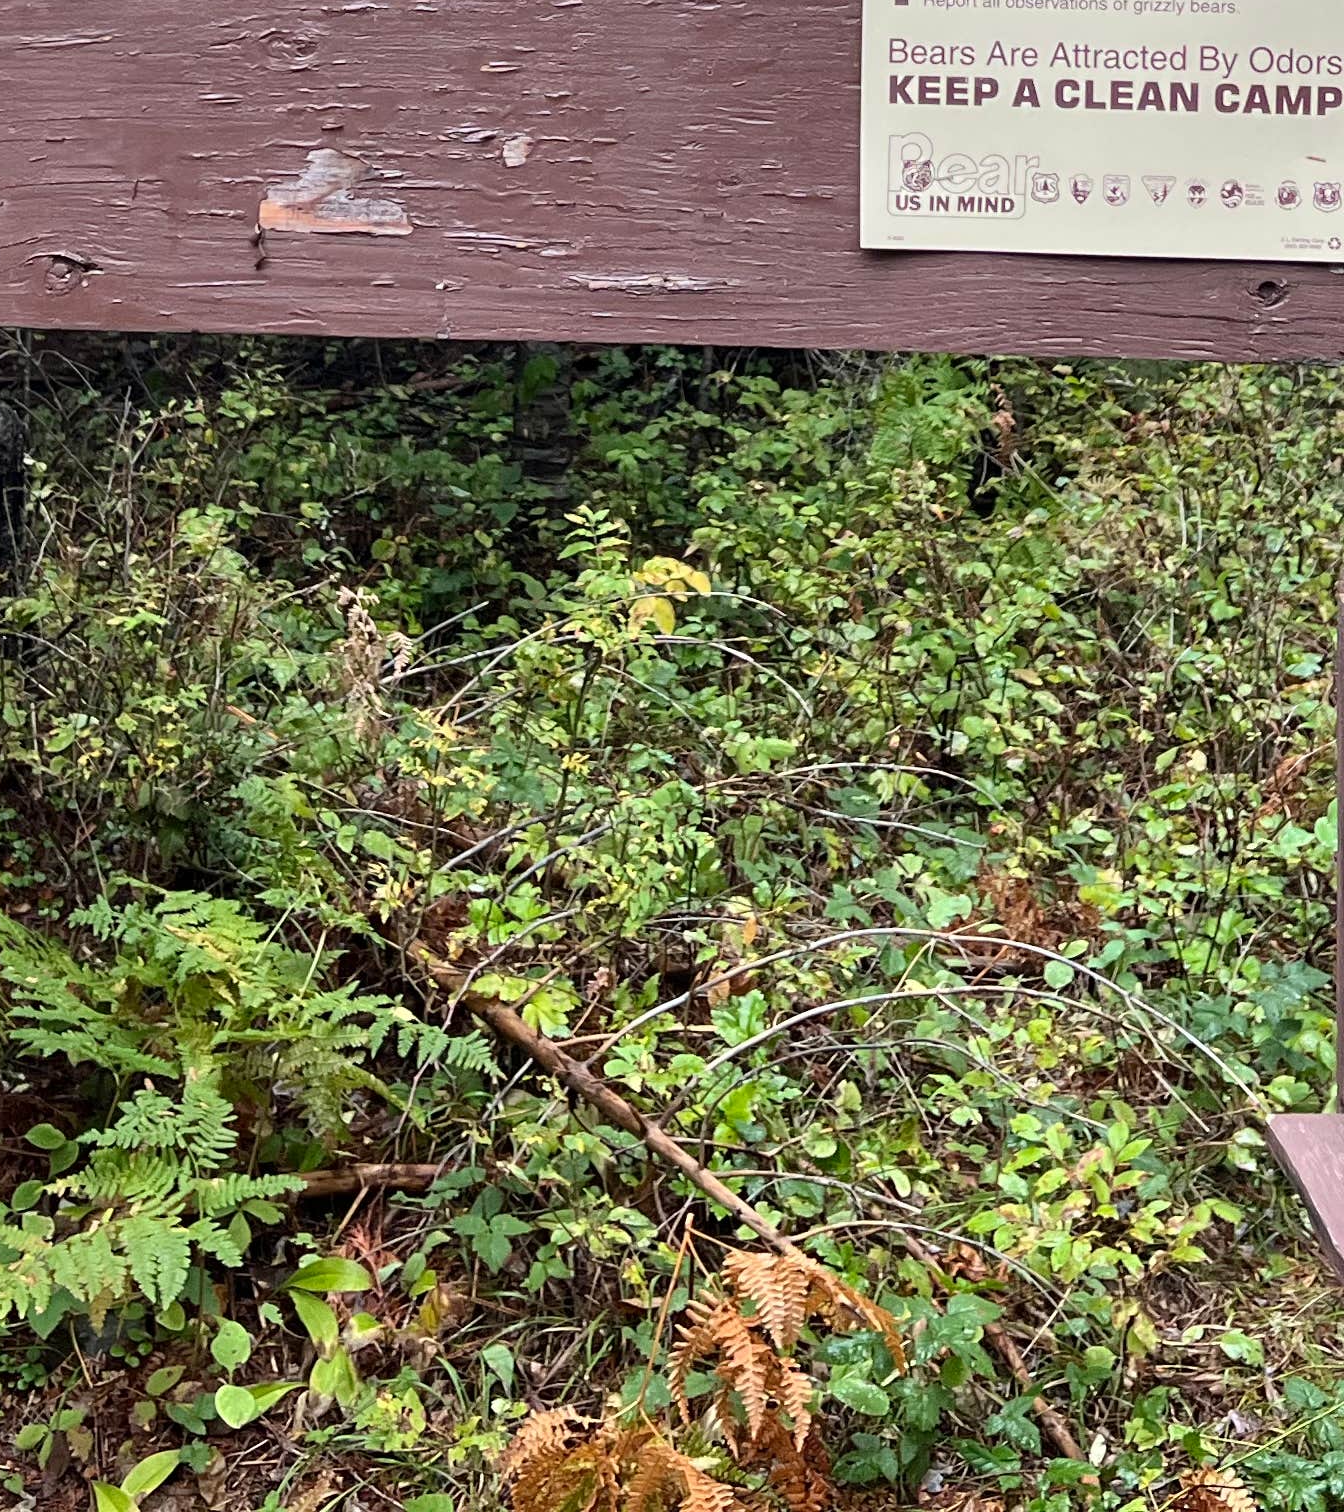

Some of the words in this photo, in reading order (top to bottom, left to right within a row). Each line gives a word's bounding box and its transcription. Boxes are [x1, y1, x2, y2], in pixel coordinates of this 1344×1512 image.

[888, 38, 975, 65] Bears
[986, 40, 1038, 67] Are
[1049, 41, 1186, 71] Attracted
[1199, 45, 1238, 76] By
[1249, 46, 1342, 75] Odors
[888, 74, 999, 106] KEEP
[1012, 78, 1040, 107] A
[1054, 78, 1199, 112] CLEAN
[1214, 83, 1343, 116] CAMP
[895, 194, 921, 210] US
[929, 195, 949, 212] IN
[957, 195, 1014, 213] MIND
